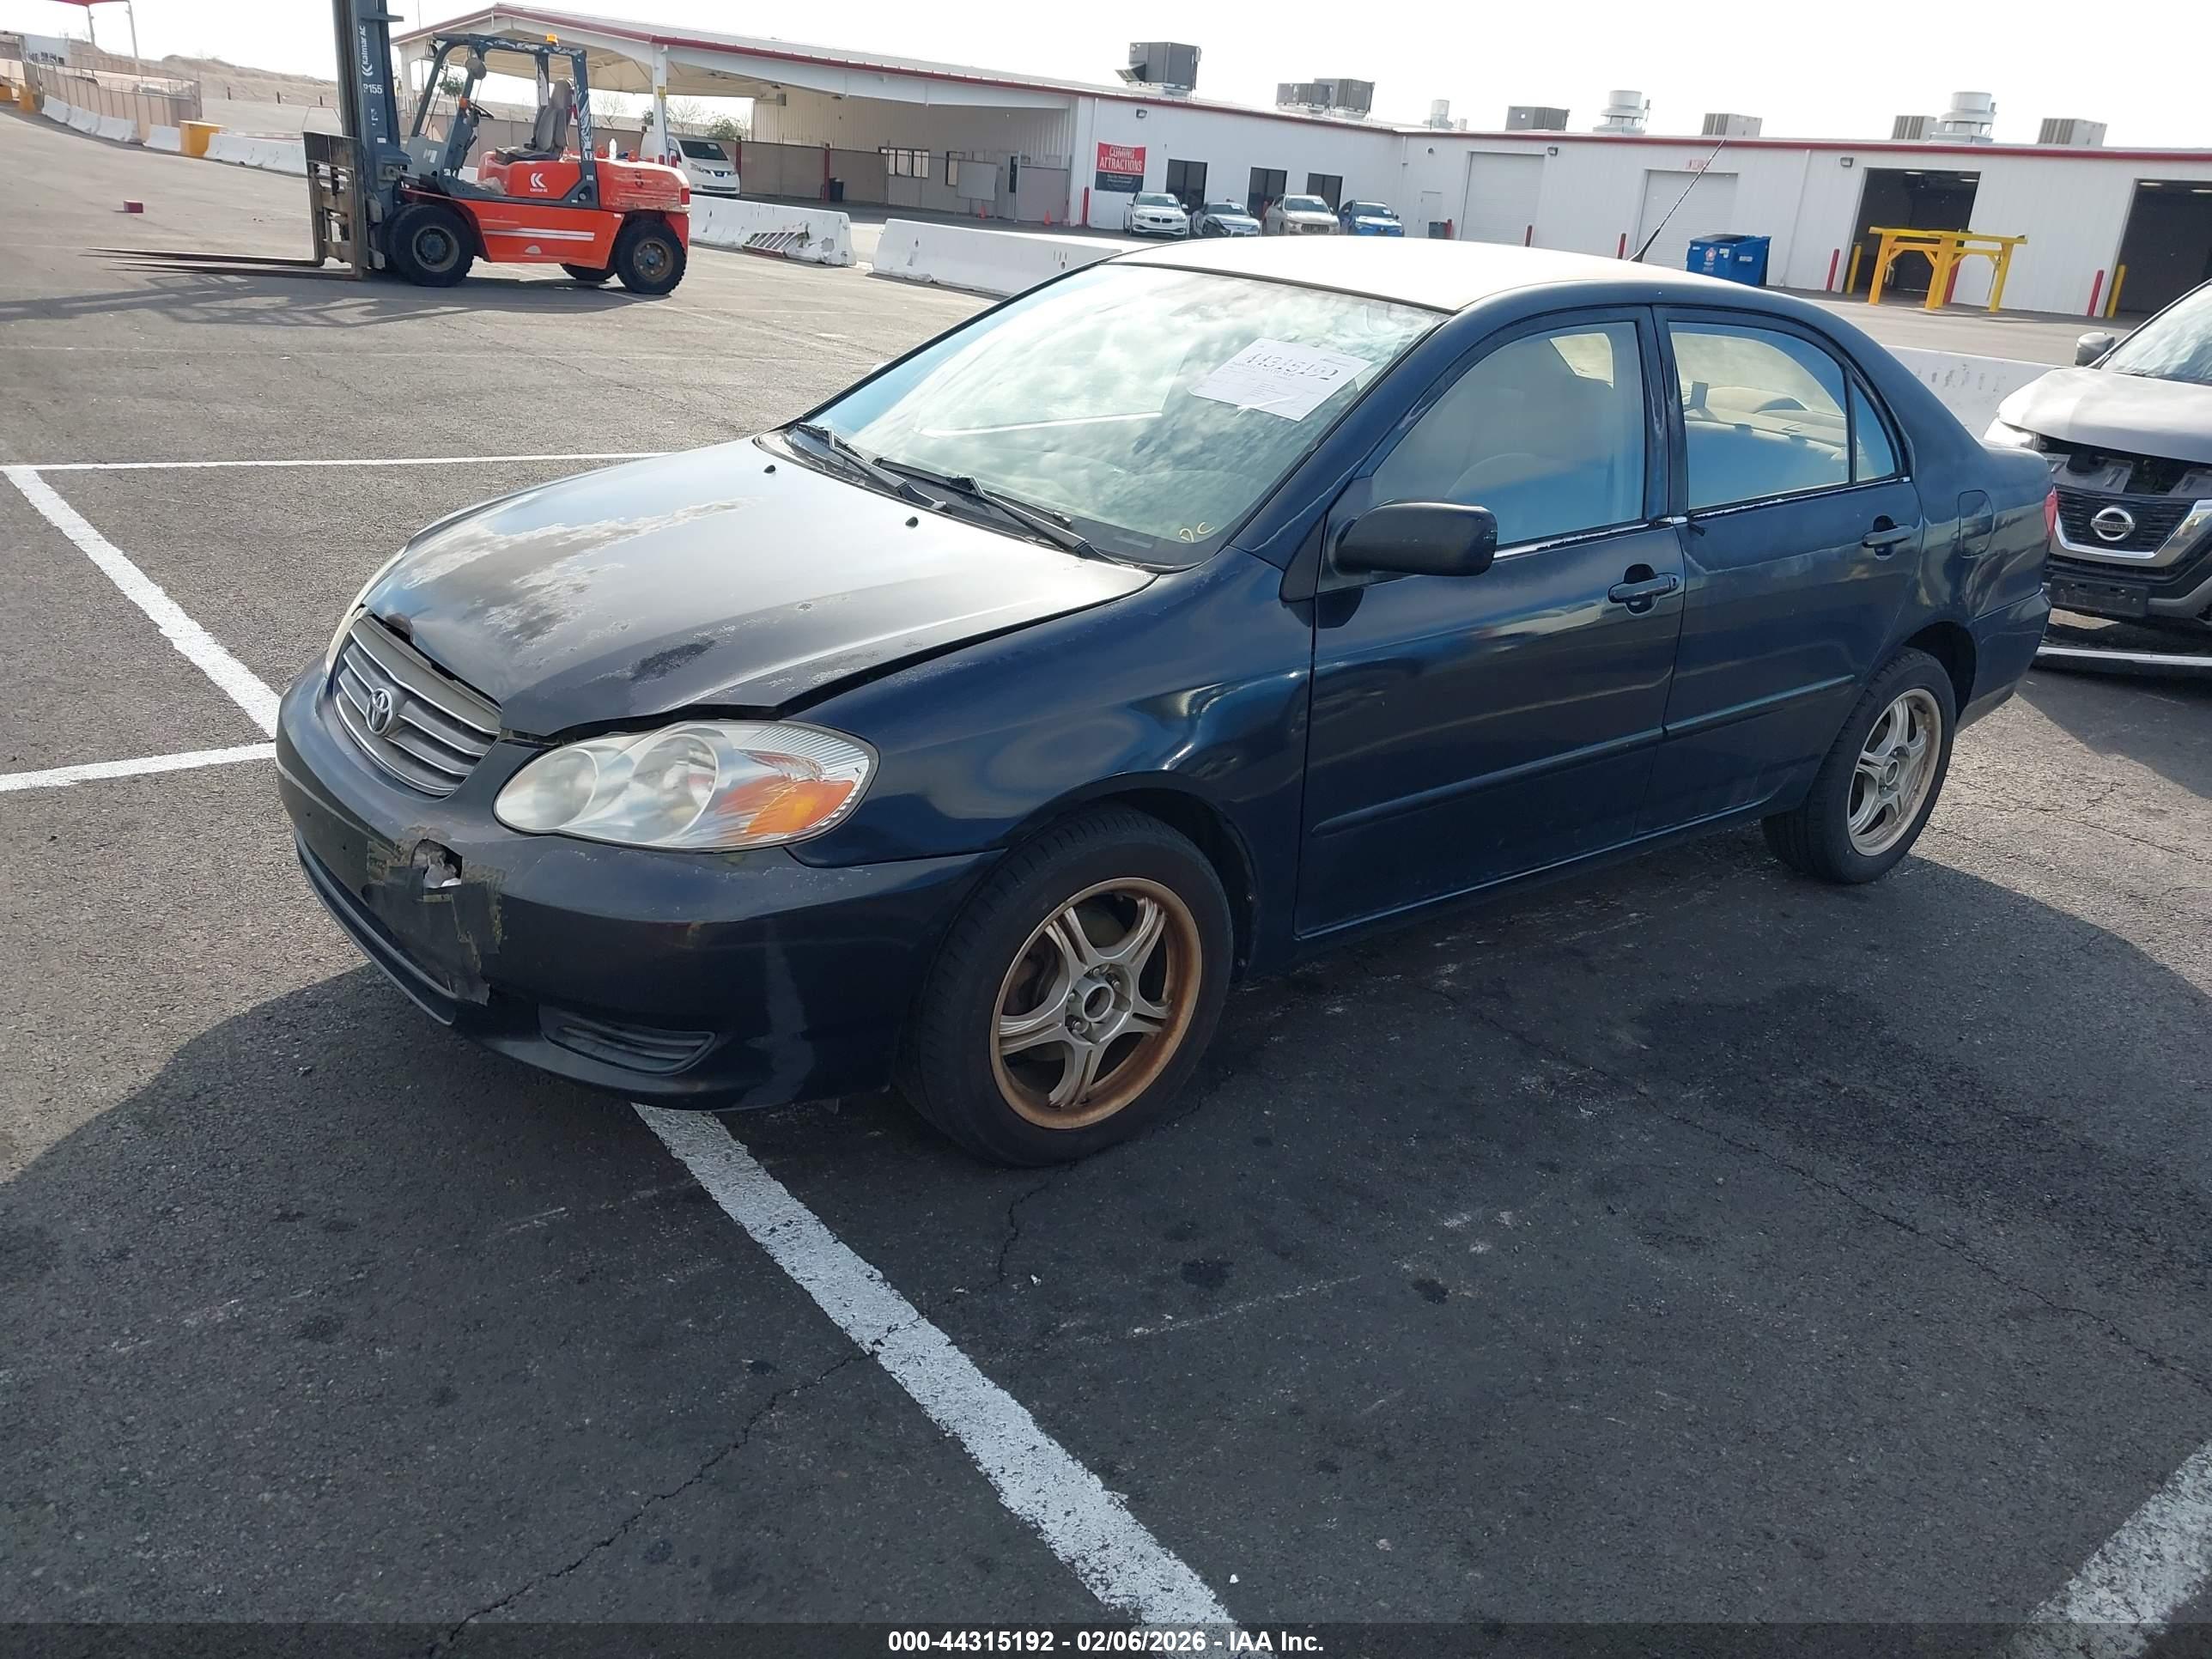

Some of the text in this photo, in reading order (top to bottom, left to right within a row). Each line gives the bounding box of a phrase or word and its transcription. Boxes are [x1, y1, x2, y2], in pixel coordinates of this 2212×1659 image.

[1109, 147, 1135, 159] COMING
[1099, 156, 1142, 172] ATTRACTIONS
[2094, 521, 2130, 531] NISSAN
